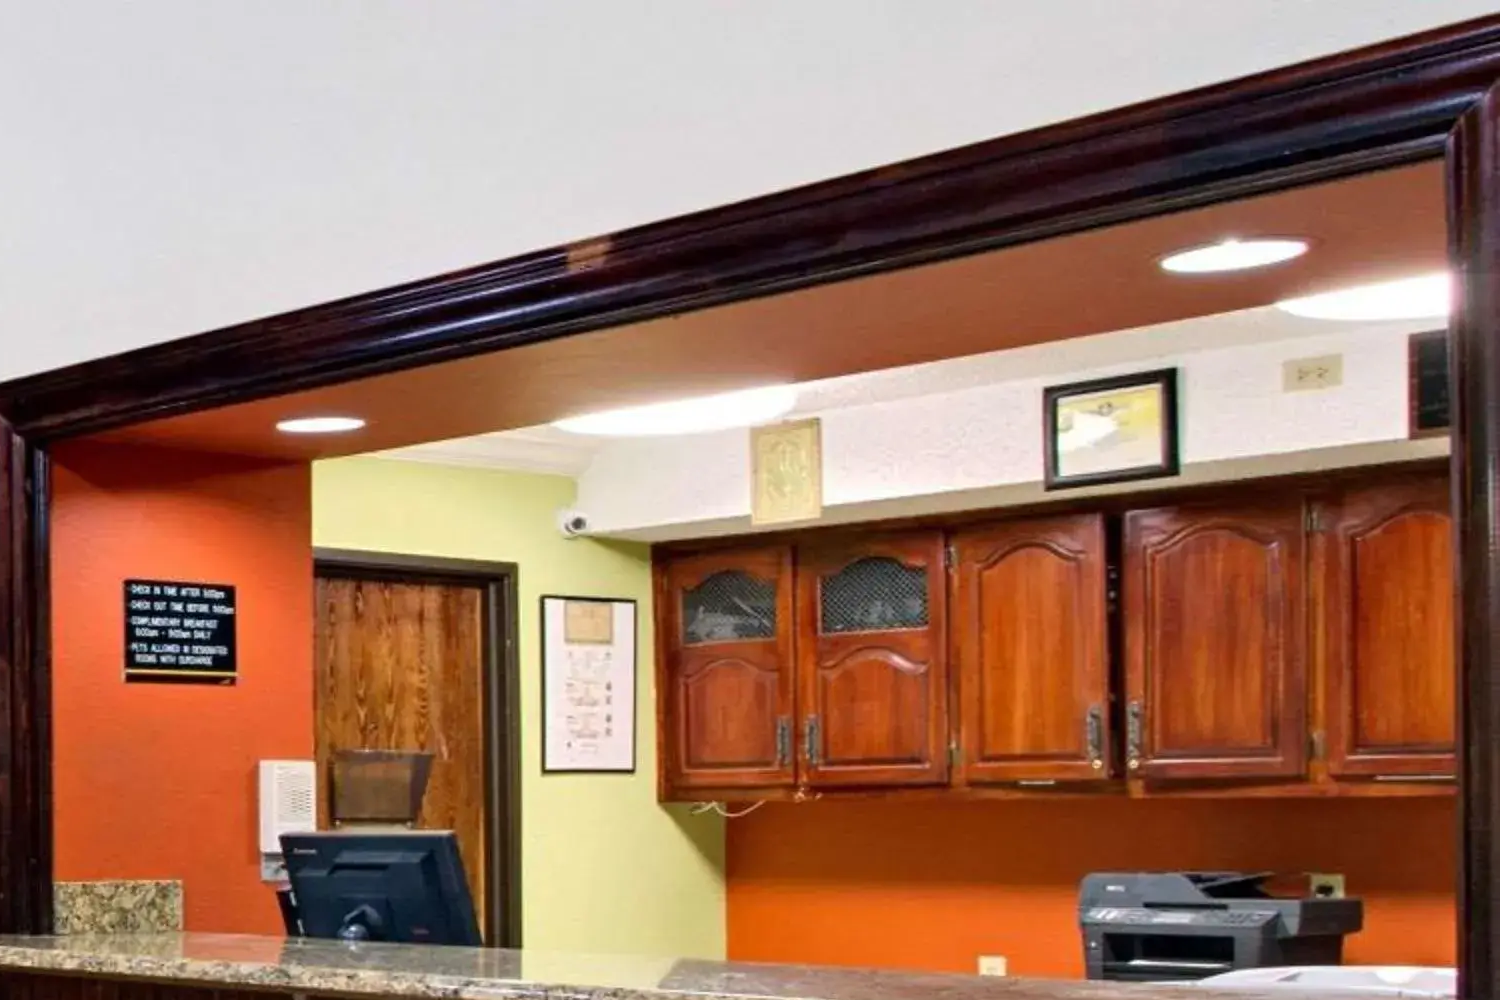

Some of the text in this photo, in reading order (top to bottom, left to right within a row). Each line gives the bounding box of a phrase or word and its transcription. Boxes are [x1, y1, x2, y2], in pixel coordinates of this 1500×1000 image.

[131, 584, 151, 594] CHECK
[154, 586, 160, 595] IN
[163, 586, 177, 596] TIME
[180, 587, 200, 597] AFTER
[131, 601, 151, 610] CHECK
[154, 602, 167, 611] OUT
[170, 602, 184, 612] TIME
[186, 603, 209, 613] BEFORE
[183, 618, 218, 629] BREAKFAST
[193, 630, 211, 639] DAILY
[131, 643, 148, 652] PETS
[151, 643, 180, 653] ALLOWED
[135, 654, 157, 663] ROOMS
[160, 655, 176, 664] WITH
